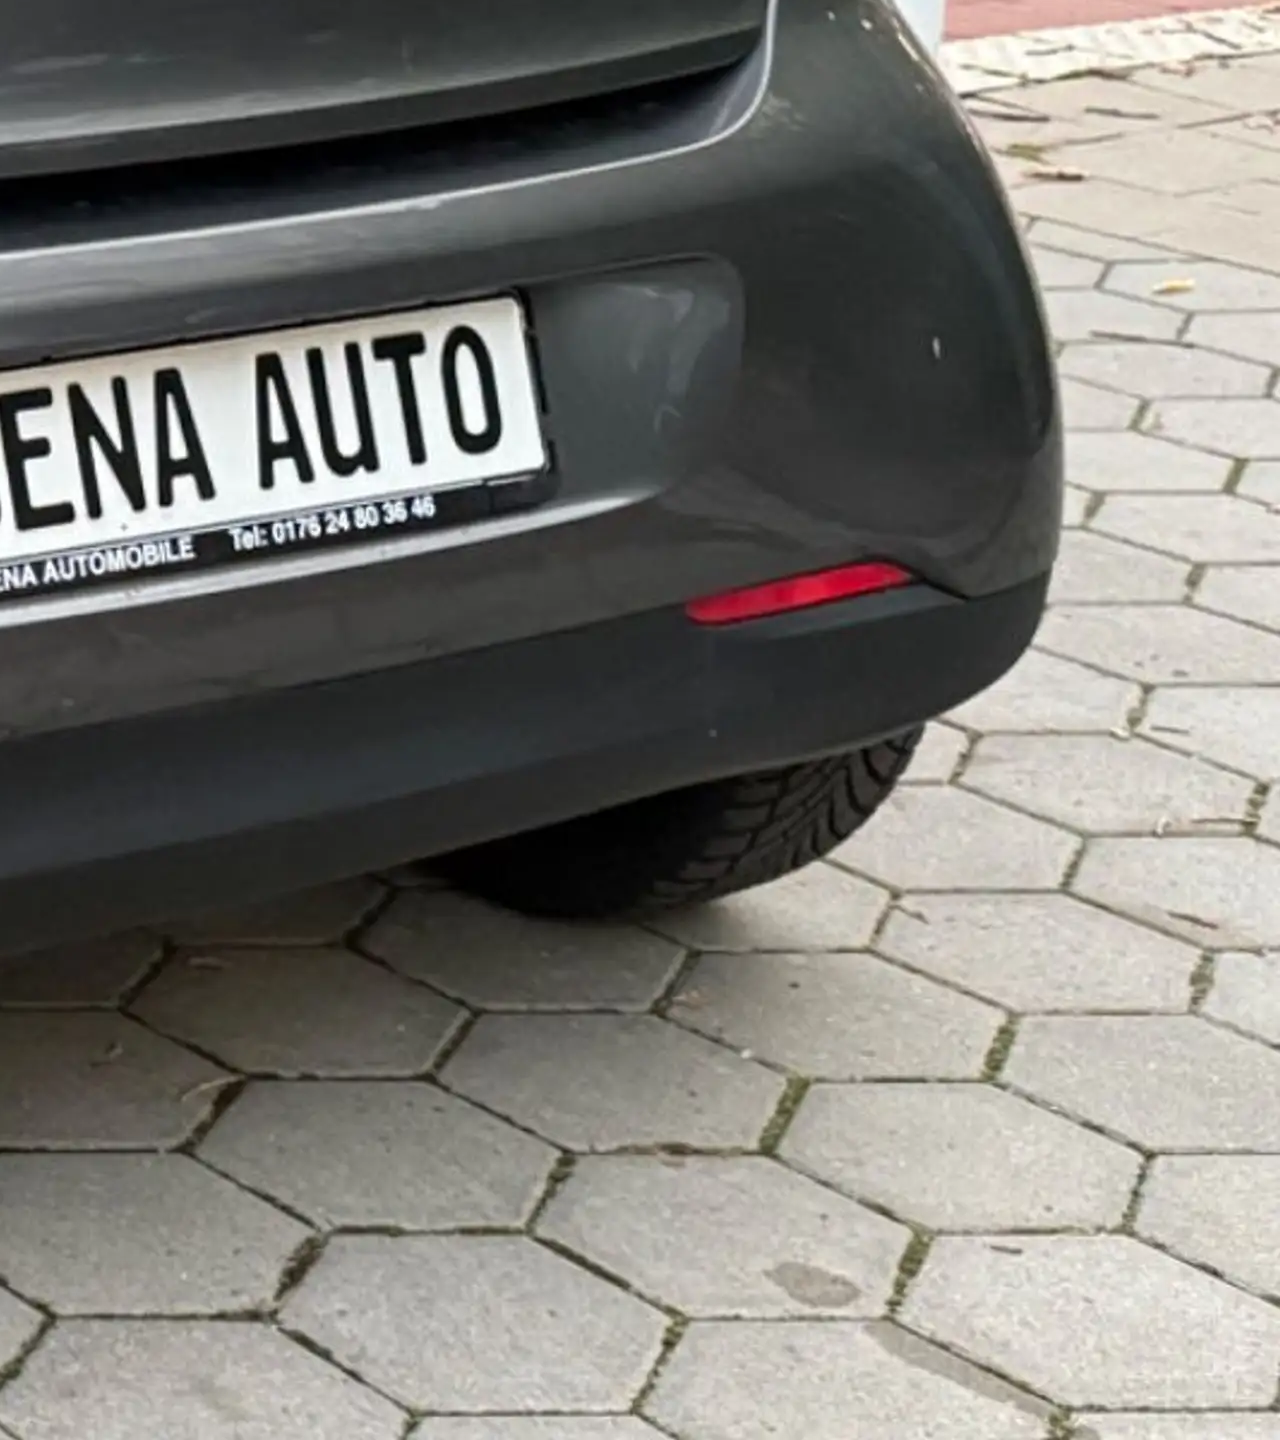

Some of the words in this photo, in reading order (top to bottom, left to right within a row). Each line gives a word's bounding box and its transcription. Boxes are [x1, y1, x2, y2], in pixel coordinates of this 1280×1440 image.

[255, 324, 502, 490] AUTO
[43, 535, 195, 585] AUTOMOBILE
[228, 523, 268, 551] Tel:
[272, 514, 322, 544] 0176
[325, 511, 351, 535] 24
[354, 504, 380, 529] 80
[382, 500, 408, 524] 36
[411, 495, 437, 519] 46
